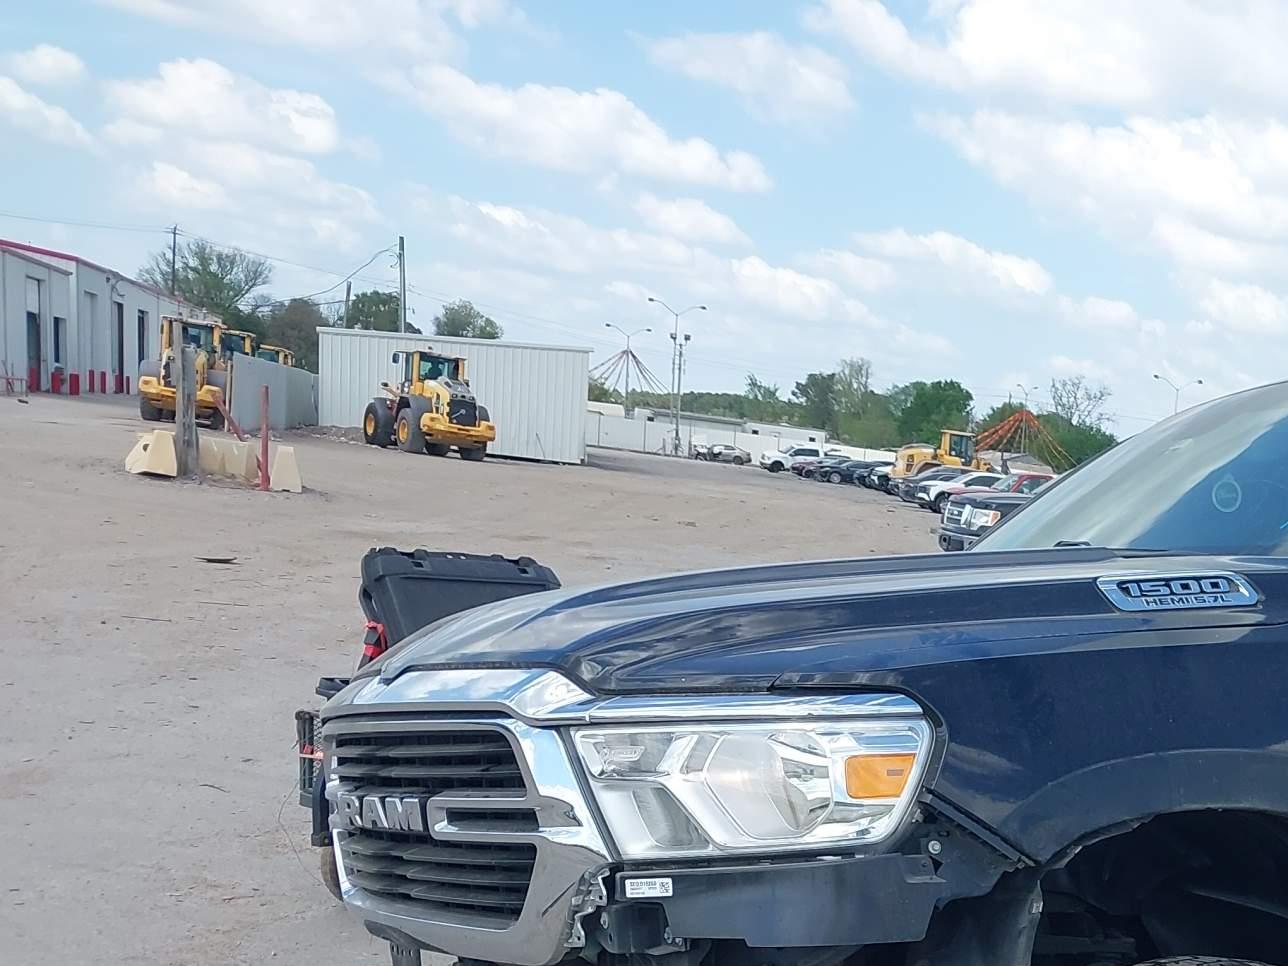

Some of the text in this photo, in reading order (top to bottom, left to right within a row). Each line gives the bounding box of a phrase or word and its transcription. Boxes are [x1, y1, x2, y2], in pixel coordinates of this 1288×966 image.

[1122, 578, 1230, 597] 1500
[1144, 595, 1233, 607] HEMI 5.7L
[337, 792, 424, 832] RAM
